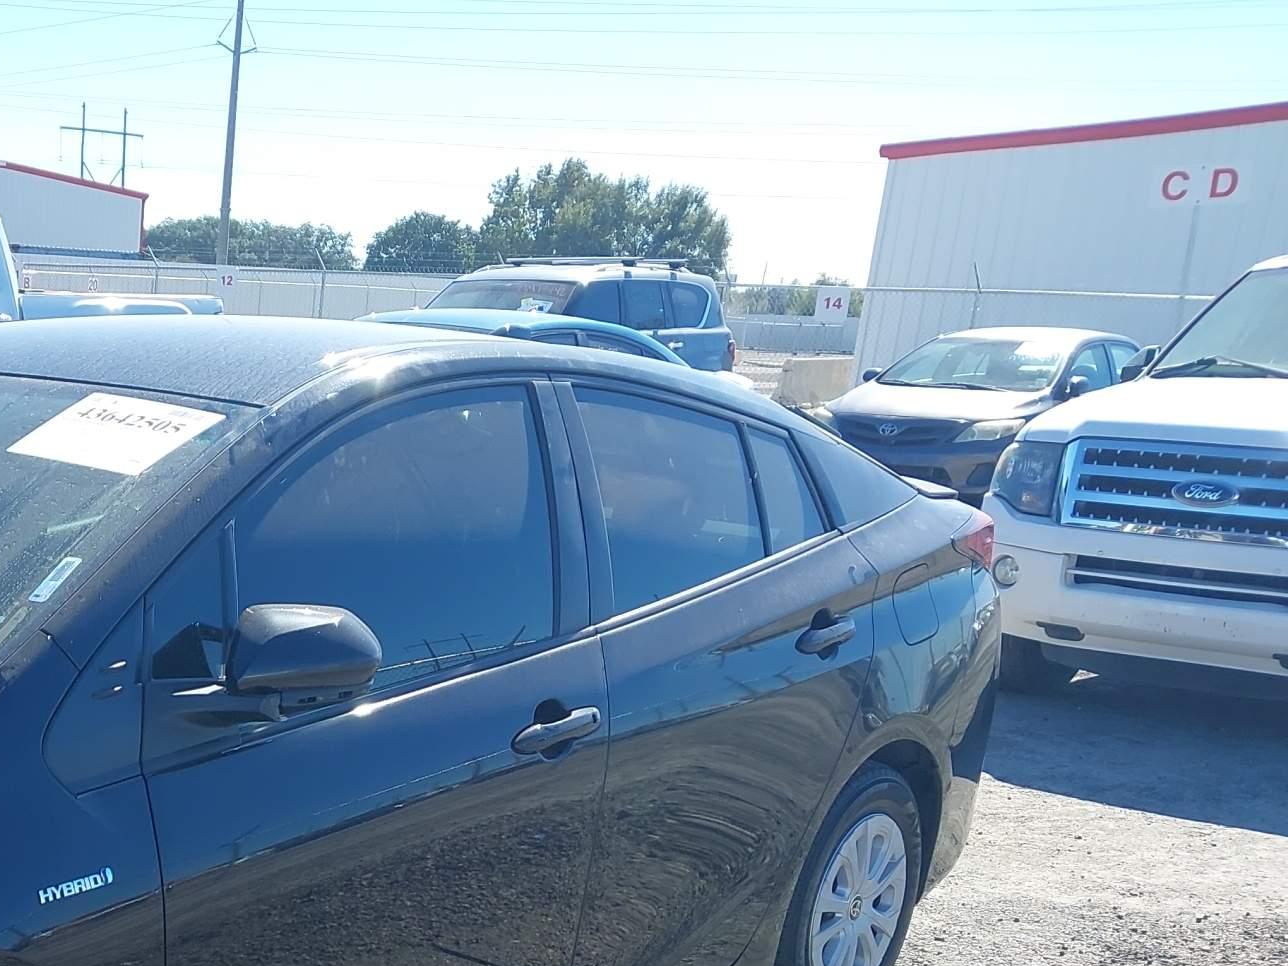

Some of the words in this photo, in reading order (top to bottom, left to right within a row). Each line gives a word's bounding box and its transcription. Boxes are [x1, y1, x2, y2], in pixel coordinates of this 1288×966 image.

[1162, 170, 1190, 201] C
[1209, 167, 1239, 198] D
[221, 275, 233, 286] 12
[823, 296, 843, 310] 14
[77, 406, 188, 435] 43642505
[1184, 483, 1223, 500] Ford
[38, 872, 105, 904] HYBRID
